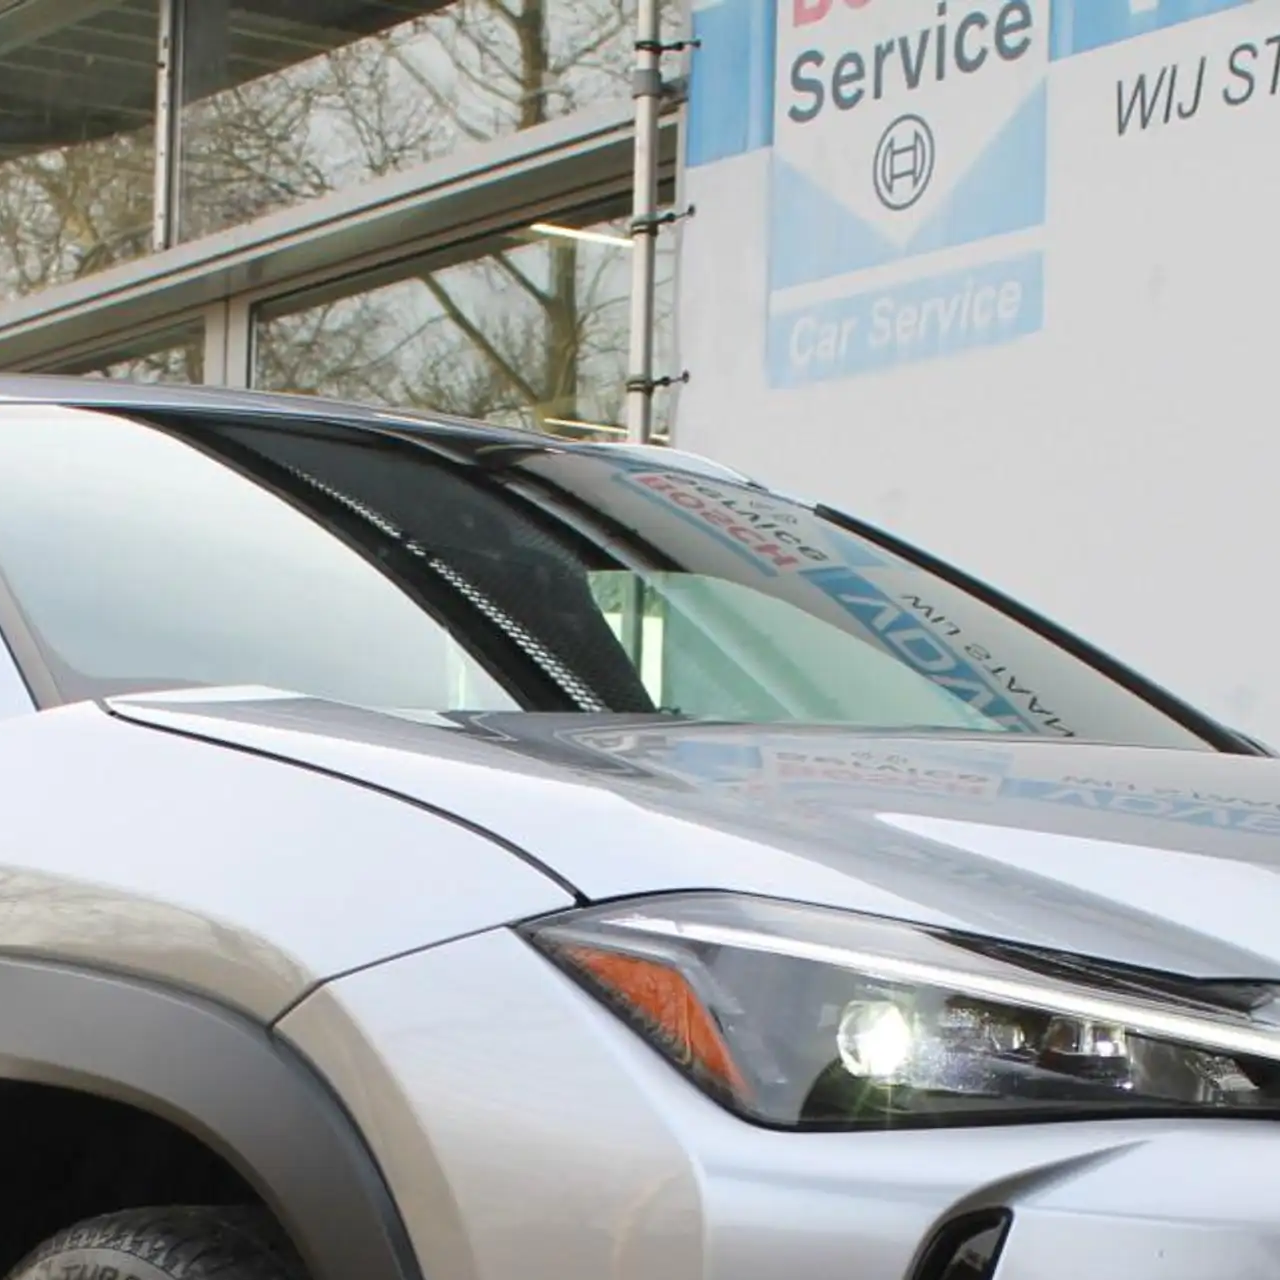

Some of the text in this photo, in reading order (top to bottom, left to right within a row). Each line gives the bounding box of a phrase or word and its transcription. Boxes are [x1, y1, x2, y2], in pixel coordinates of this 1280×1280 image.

[787, 0, 1033, 124] Service
[1114, 55, 1207, 137] WIJ
[789, 278, 1023, 367] Car Service
